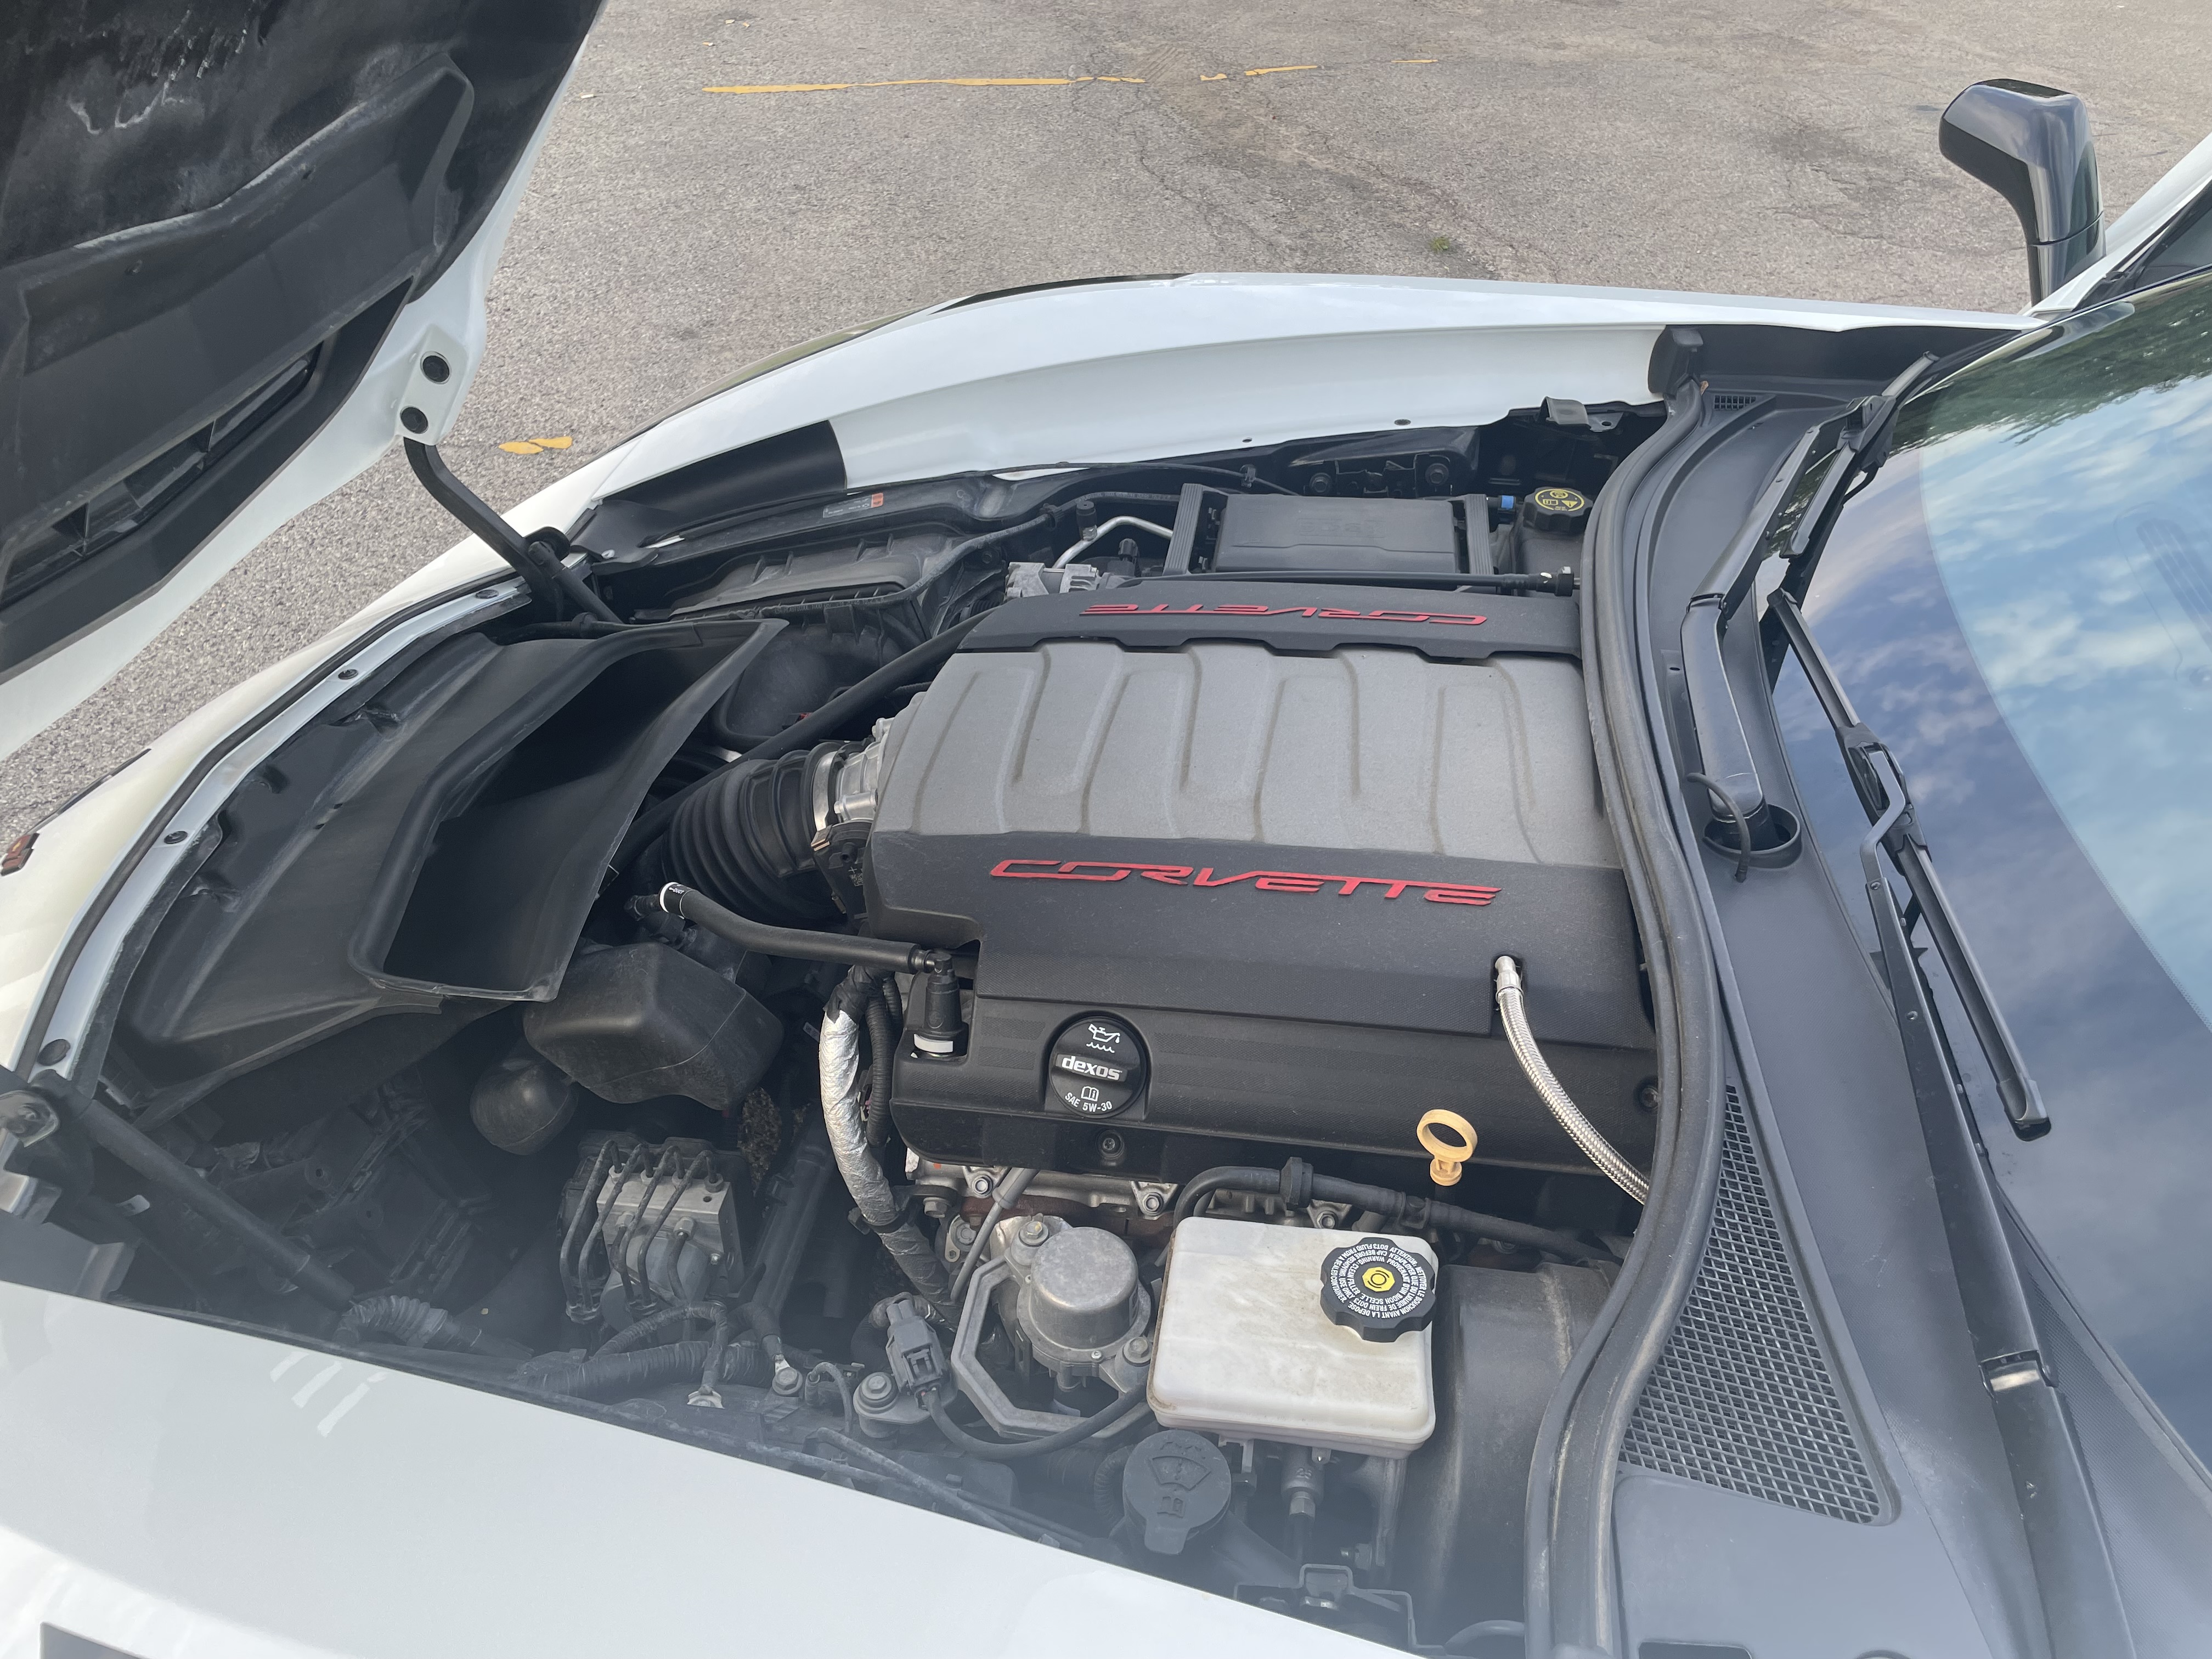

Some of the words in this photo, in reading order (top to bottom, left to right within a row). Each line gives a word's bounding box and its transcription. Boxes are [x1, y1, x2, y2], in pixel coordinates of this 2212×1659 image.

[1079, 603, 1488, 625] CORVETTE
[990, 859, 1502, 906] CORVETTE
[1062, 1056, 1121, 1080] dexos
[1065, 1092, 1080, 1108] SAE
[1082, 1101, 1113, 1113] 5W-30
[1341, 1248, 1356, 1259] FROM
[1353, 1250, 1376, 1260] BEFORE
[1356, 1244, 1372, 1252] FLUID
[1331, 1259, 1342, 1276] SEALED
[1347, 1263, 1359, 1278] CLEAN
[1386, 1259, 1410, 1283] PROVENANT
[1339, 1278, 1347, 1288] USE
[1415, 1266, 1427, 1290] NETTOYER
[1342, 1288, 1355, 1299] ONLY
[1347, 1278, 1361, 1295] FILLER
[1353, 1298, 1368, 1308] DOT3
[1385, 1293, 1403, 1304] BIDON
[1395, 1293, 1415, 1308] LIQUIDE
[1400, 1296, 1422, 1314] BOUCHON
[1381, 1310, 1400, 1318] AVANT
